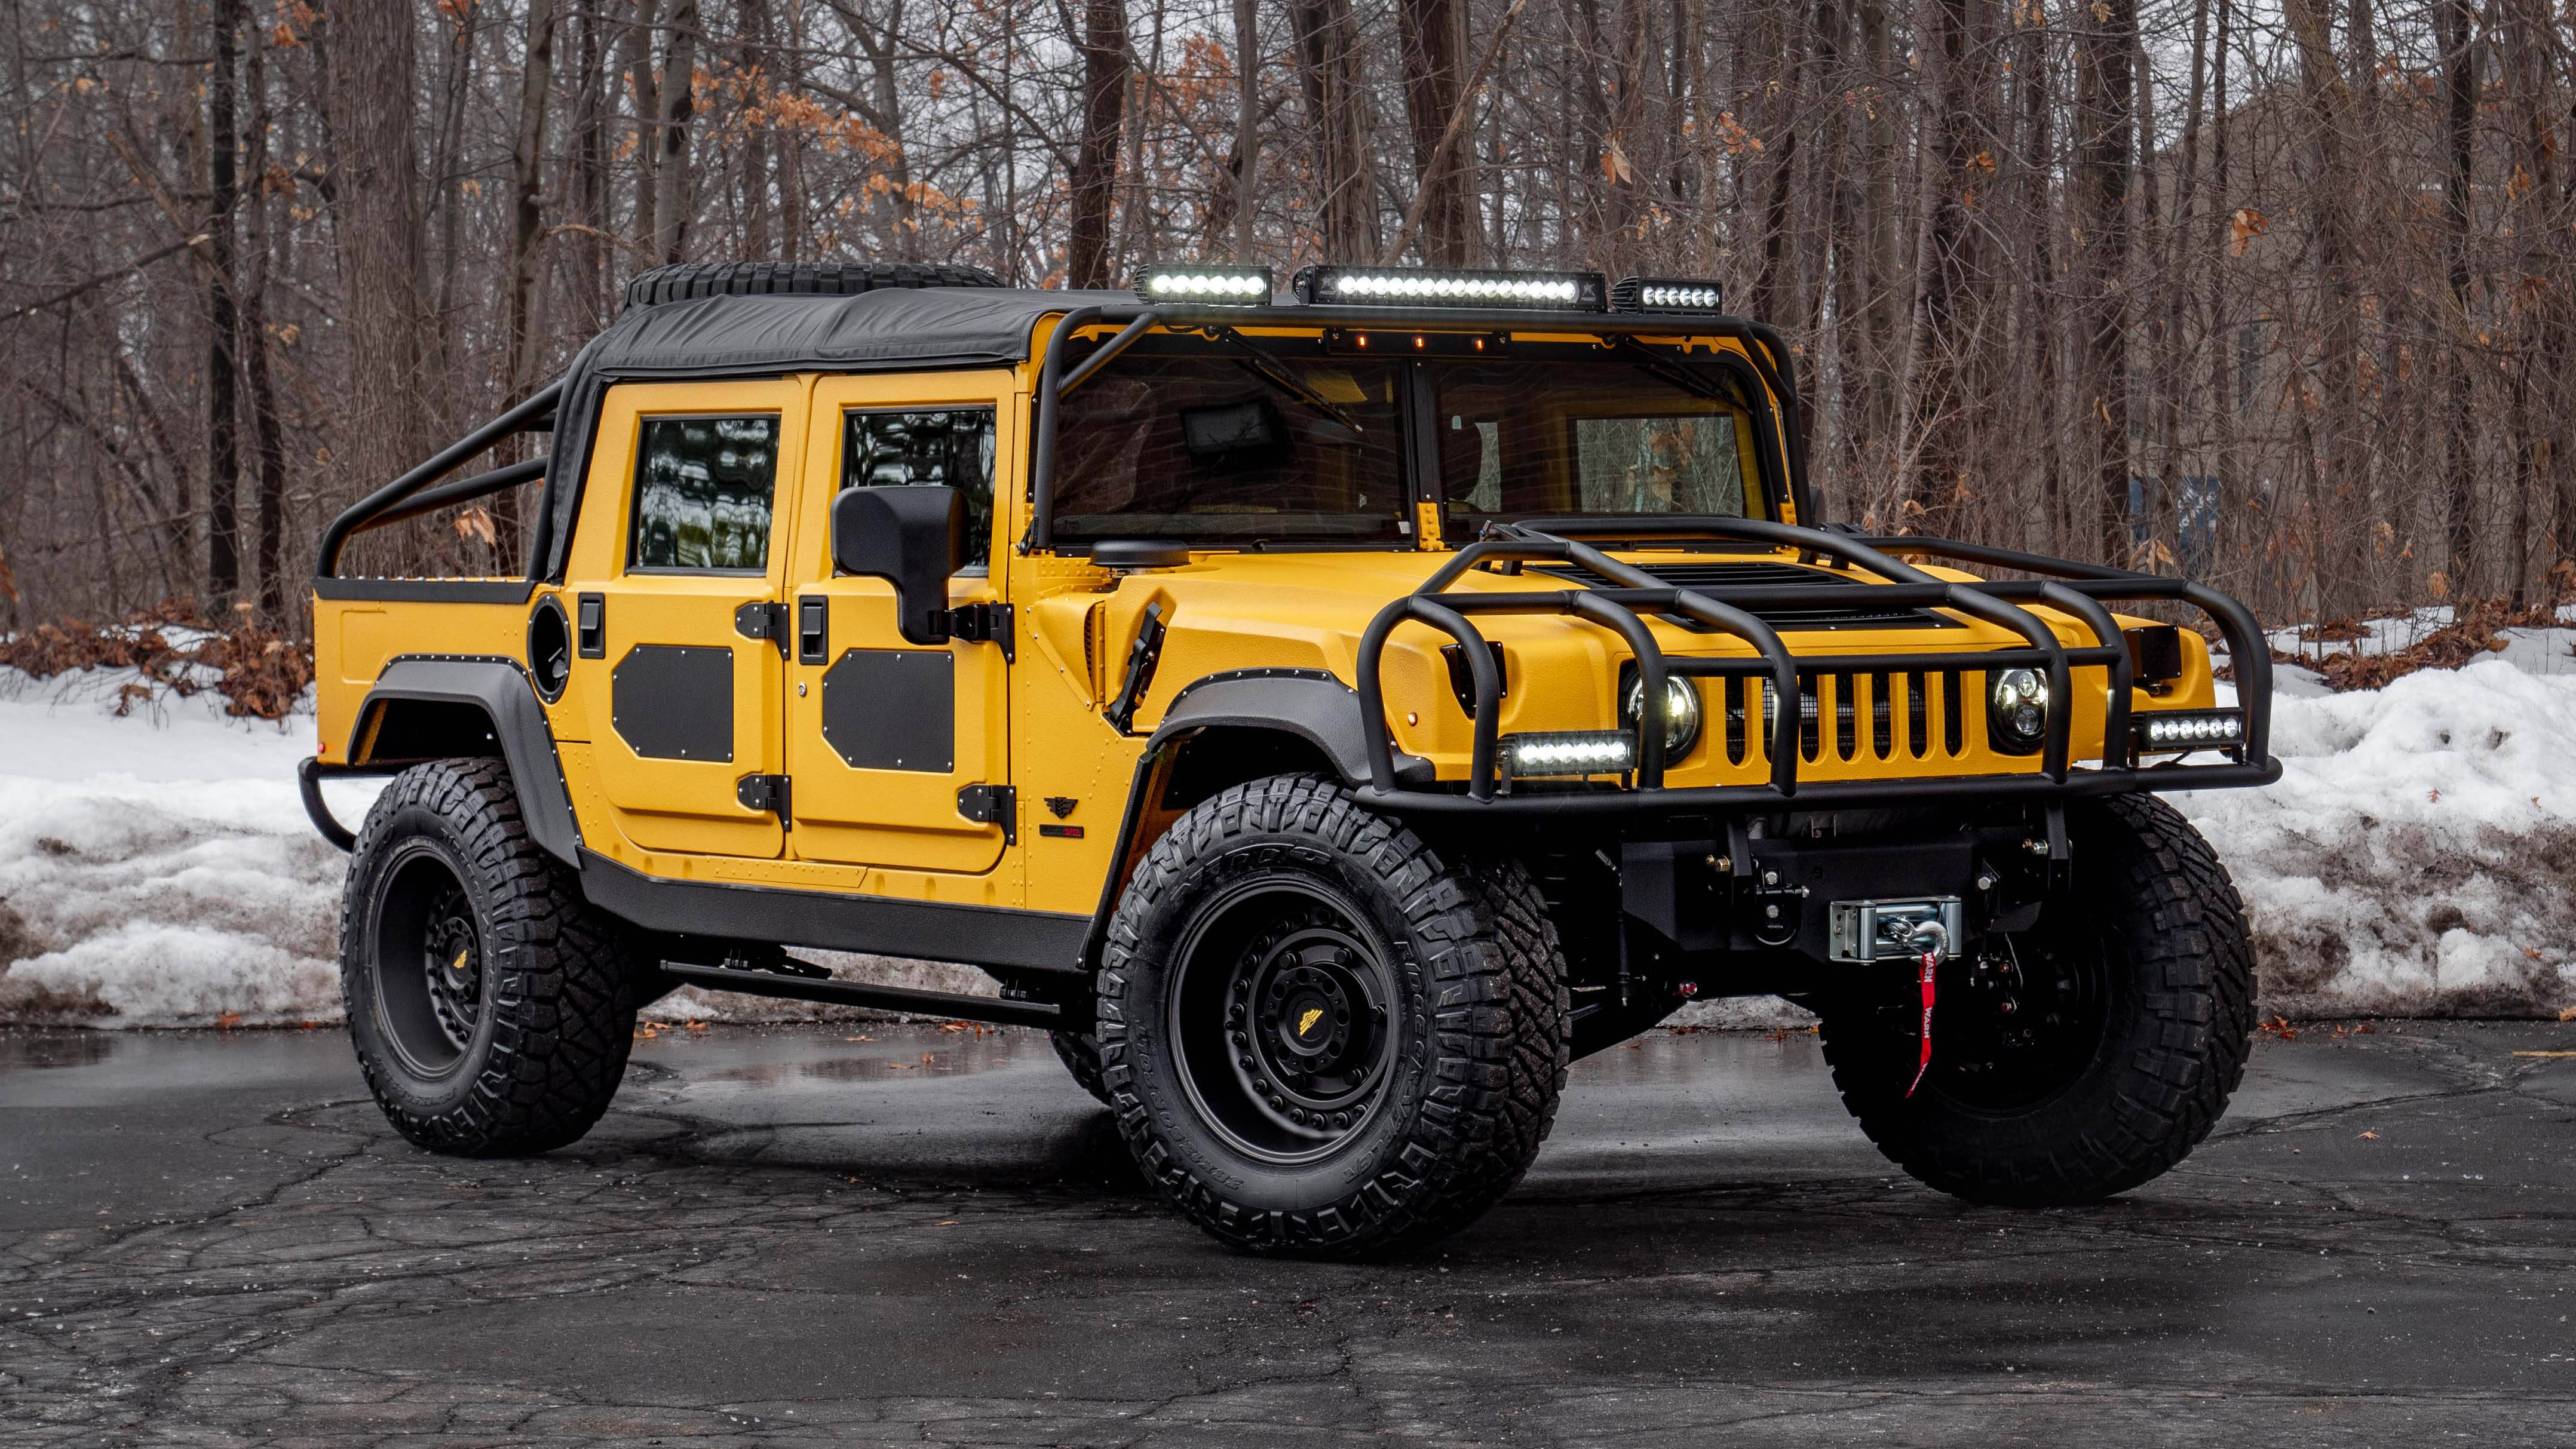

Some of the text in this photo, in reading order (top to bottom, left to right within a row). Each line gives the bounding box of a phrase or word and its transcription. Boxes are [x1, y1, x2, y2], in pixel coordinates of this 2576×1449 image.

[1924, 952, 1934, 983] WARN
[1393, 941, 1427, 1036] RIDGE
[1924, 1006, 1932, 1038] WARN
